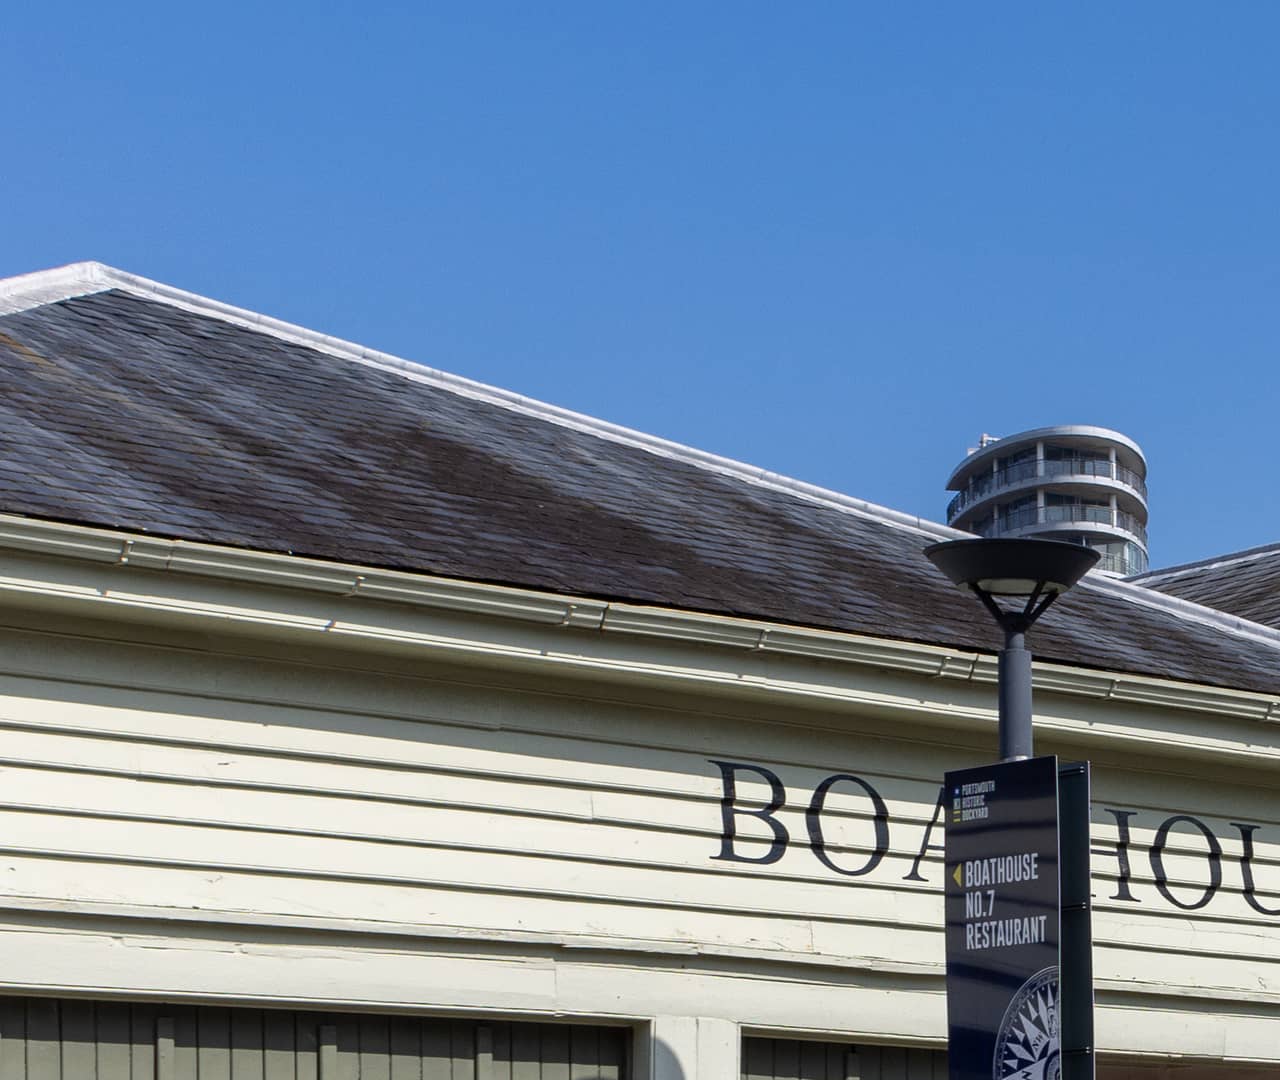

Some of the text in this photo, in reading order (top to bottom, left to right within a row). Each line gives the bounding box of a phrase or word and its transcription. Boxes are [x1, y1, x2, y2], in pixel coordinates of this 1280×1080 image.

[962, 780, 995, 795] PORTSMOUTH
[962, 795, 985, 808] HISTORIC
[962, 807, 988, 821] DOCKYARD
[965, 853, 1039, 887] BOATHOUSE
[965, 890, 995, 919] NO.7
[966, 915, 1047, 951] RESTAURANT
